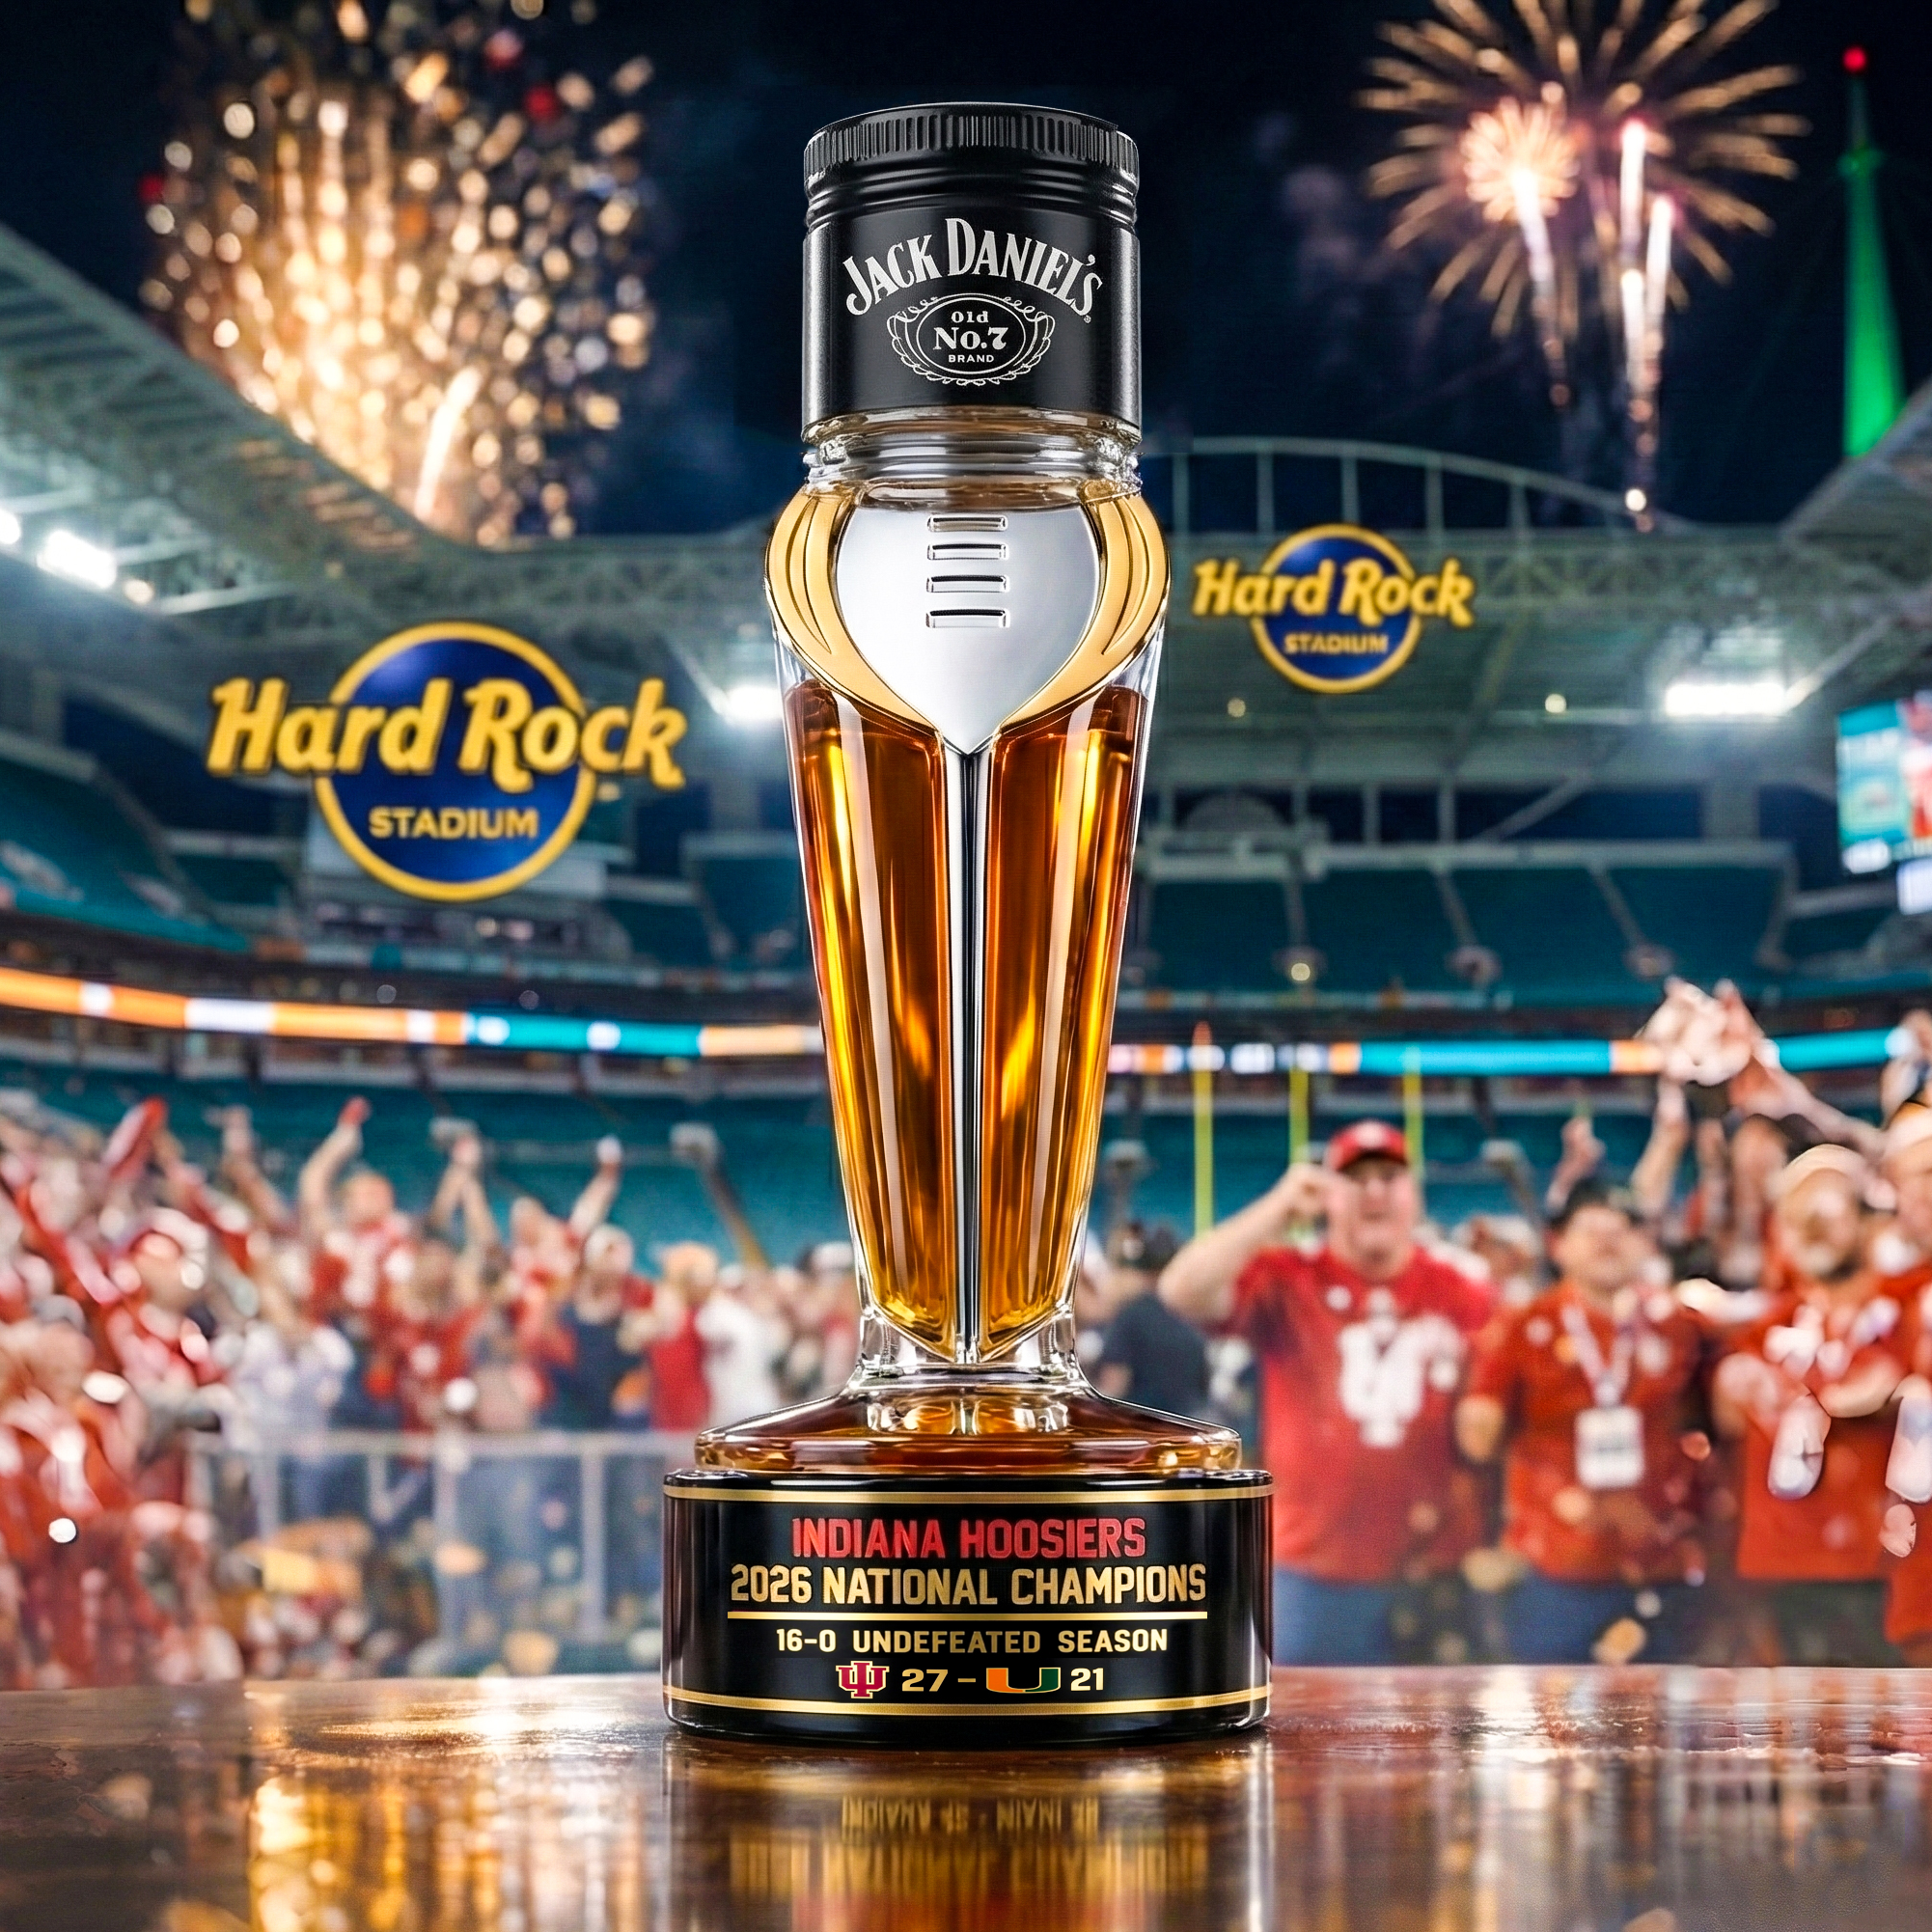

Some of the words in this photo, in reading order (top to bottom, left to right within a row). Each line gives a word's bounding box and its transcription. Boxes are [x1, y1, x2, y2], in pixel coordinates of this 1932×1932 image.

[842, 235, 941, 316] JACK
[945, 217, 1103, 317] DANIEL'S
[951, 311, 989, 324] Old
[948, 354, 995, 364] BRAND
[1192, 558, 1336, 616] Hard
[1339, 557, 1474, 626] Rock
[1283, 633, 1388, 654] STADIUM
[207, 677, 453, 773] Hard
[457, 677, 687, 792] Rock
[369, 807, 538, 839] STADIUM
[791, 1518, 943, 1558] INDIANA
[960, 1517, 1146, 1558] HOOSIERS
[731, 1563, 812, 1603] 2026
[823, 1567, 998, 1604] NATIONAL
[1010, 1563, 1207, 1604] CHAMPIONS
[777, 1628, 837, 1652] 16-0
[853, 1630, 1041, 1653] UNDEFEATED
[1059, 1629, 1168, 1651] SEASON
[901, 1669, 949, 1692] 27
[1070, 1669, 1104, 1691] 21
